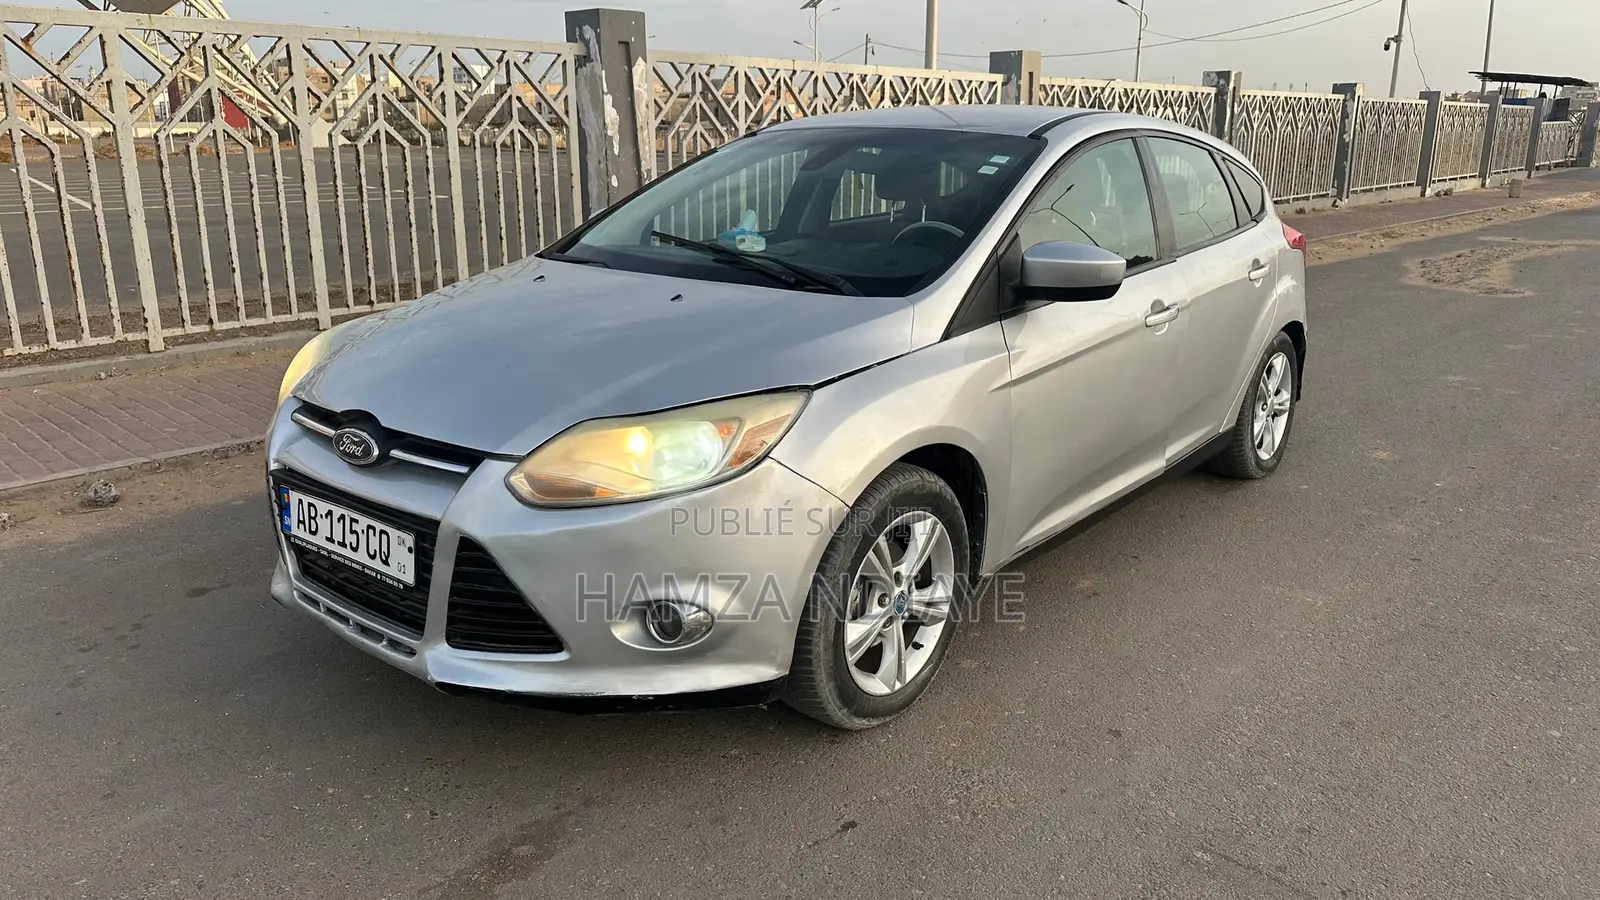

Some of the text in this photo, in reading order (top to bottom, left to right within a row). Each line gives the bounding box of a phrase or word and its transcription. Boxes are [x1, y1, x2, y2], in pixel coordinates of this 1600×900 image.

[339, 433, 365, 457] Ford
[397, 535, 407, 548] DK
[397, 562, 406, 575] 01
